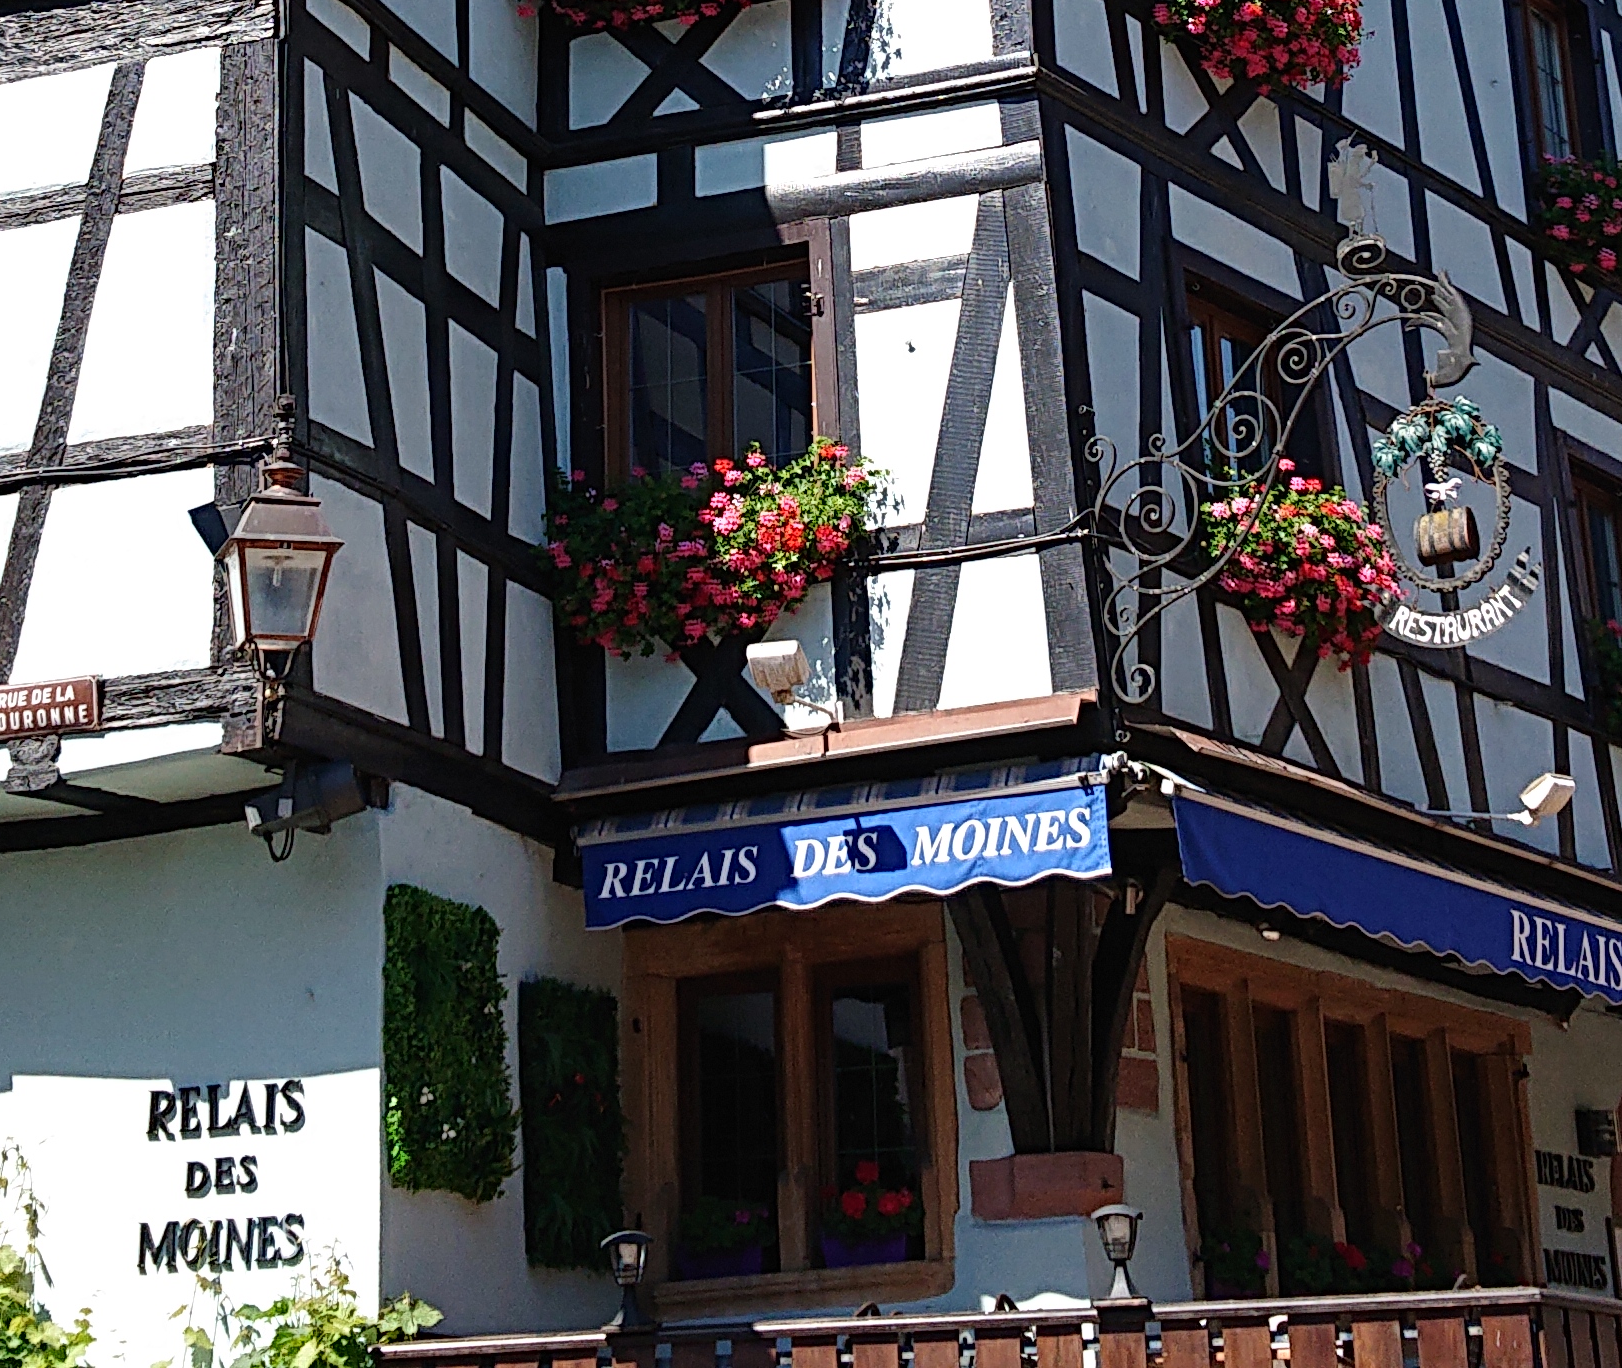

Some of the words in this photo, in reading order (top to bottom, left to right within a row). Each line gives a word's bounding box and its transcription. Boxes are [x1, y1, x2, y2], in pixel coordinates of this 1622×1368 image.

[1389, 584, 1522, 644] RESTAURANT
[31, 687, 53, 705] DE
[55, 685, 75, 702] LA
[598, 845, 758, 899] RELAIS
[791, 832, 878, 878] DES
[910, 807, 1093, 866] MOINES
[146, 1079, 306, 1141] RELAIS
[184, 1155, 258, 1198] DES
[1535, 1150, 1595, 1193] RELAIS
[1554, 1205, 1585, 1232] DES
[137, 1213, 305, 1275] MOINES
[1543, 1248, 1608, 1289] MOINES
